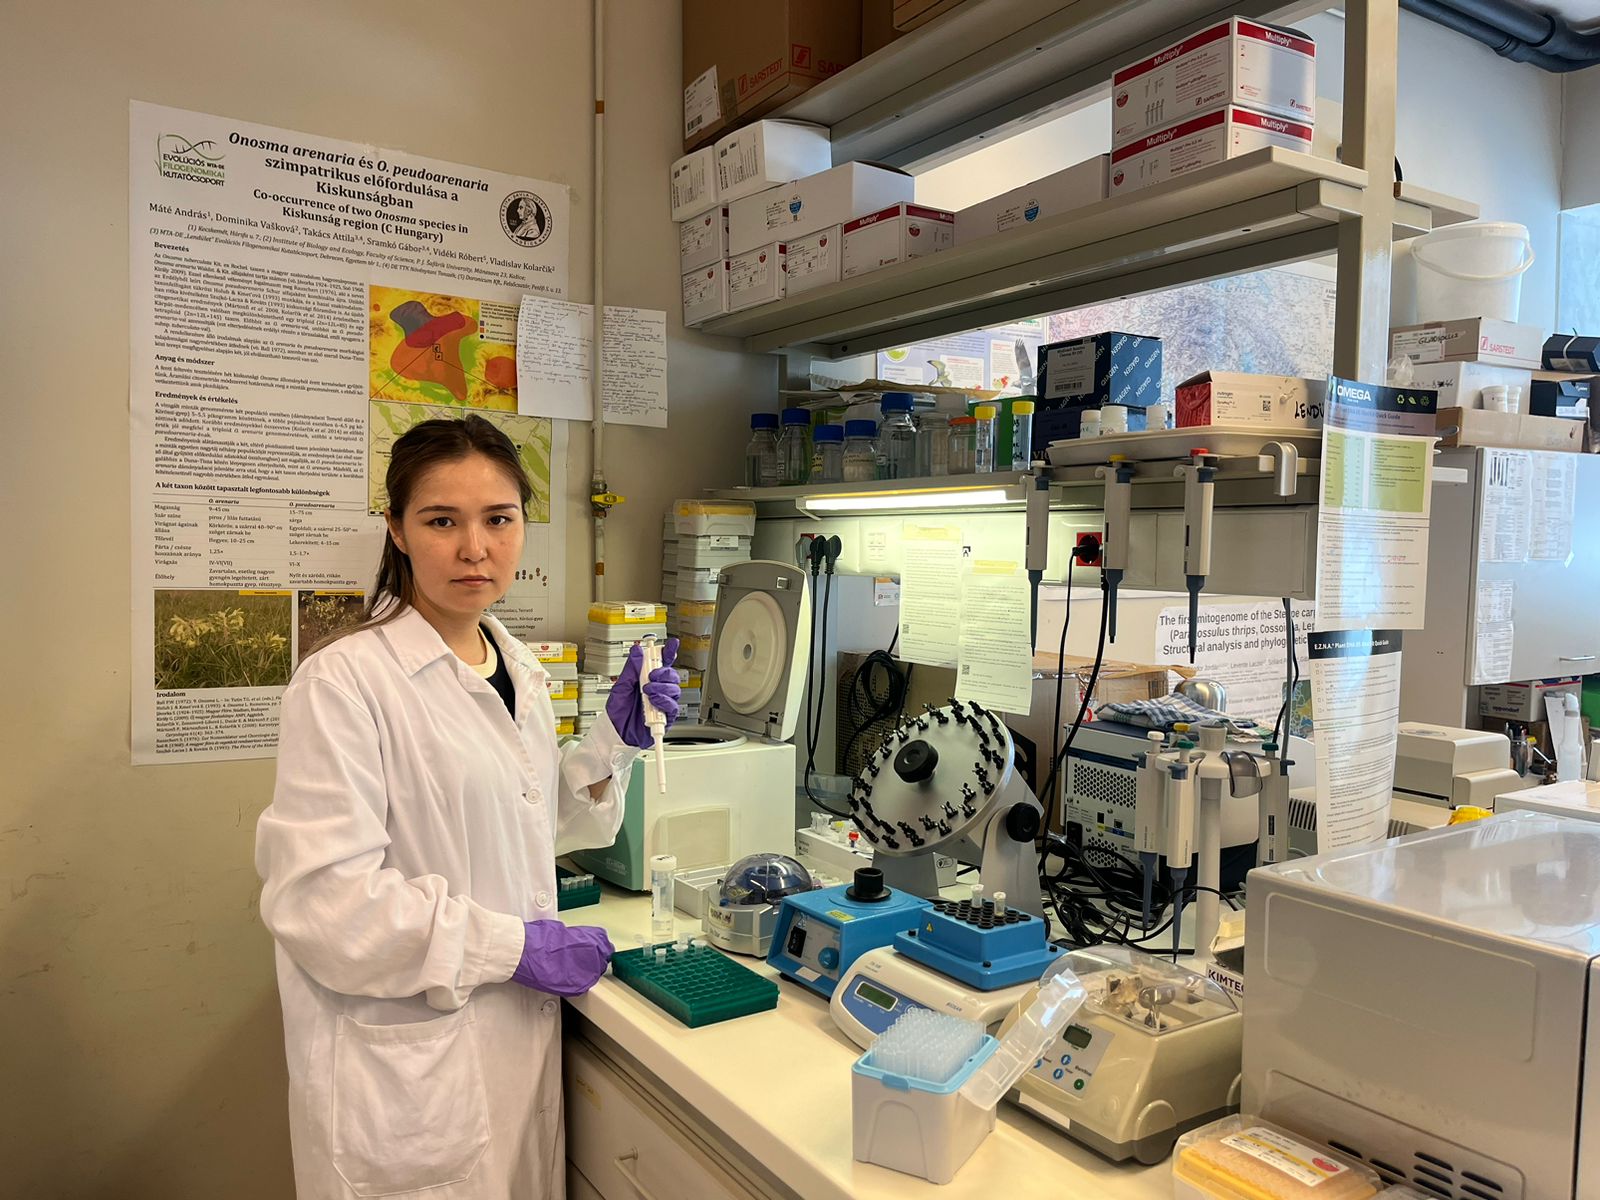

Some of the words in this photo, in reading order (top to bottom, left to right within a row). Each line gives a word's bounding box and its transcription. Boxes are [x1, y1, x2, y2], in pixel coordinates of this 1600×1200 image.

[750, 58, 784, 88] SARSTEDT
[163, 154, 205, 166] EVOLÚCIÓS
[229, 132, 288, 153] Onosma
[293, 147, 355, 166] arenaria
[359, 156, 373, 169] és
[377, 161, 389, 172] O.
[392, 166, 489, 192] peudoarenaria
[163, 162, 224, 178] FILOGENOMIKAI
[163, 170, 224, 186] KUTATÓCSOPORT
[265, 158, 360, 183] szimpatrikus
[364, 175, 448, 200] előfordulása
[451, 192, 458, 202] a
[316, 181, 413, 208] Kiskunságban
[254, 189, 336, 210] Co-occurrence
[338, 204, 350, 214] of
[352, 208, 372, 217] two
[374, 210, 416, 224] Onosma
[418, 218, 456, 232] species
[458, 224, 468, 234] in
[282, 206, 340, 226] Kiskunság
[344, 218, 378, 230] region
[382, 222, 392, 234] (C
[395, 225, 443, 243] Hungary)
[149, 202, 172, 214] Máté
[216, 214, 258, 228] Dominika
[303, 228, 331, 239] Takács
[367, 238, 396, 250] Sramkó
[432, 248, 456, 259] Vidéki
[490, 258, 521, 269] Vladislav
[154, 242, 189, 253] Bevezetés
[273, 236, 300, 246] Institute
[306, 242, 328, 252] Biology
[366, 251, 387, 260] Faculty
[388, 254, 394, 262] of
[1112, 335, 1128, 356] QIAGEN
[1489, 344, 1515, 355] SARSTEDT
[155, 354, 176, 363] Anyag
[186, 357, 215, 366] módszer
[1124, 356, 1140, 376] QIAGEN
[1145, 349, 1160, 368] QIAGEN
[1101, 364, 1119, 386] QIAGEN
[1135, 376, 1151, 397] QIAGEN
[1337, 386, 1371, 401] OMEGA
[155, 391, 198, 401] Eredmények
[208, 396, 238, 404] értékelés
[1388, 412, 1400, 420] Guide
[194, 484, 216, 492] között
[216, 485, 248, 494] tapasztalt
[250, 486, 290, 495] legfontosabb
[291, 487, 330, 498] különbségek
[1160, 616, 1175, 626] The
[1197, 613, 1248, 625] mitogenome
[1251, 611, 1259, 620] of
[1260, 611, 1271, 620] the
[1232, 626, 1258, 638] thrips,
[1207, 639, 1242, 653] analysis
[1244, 639, 1258, 649] and
